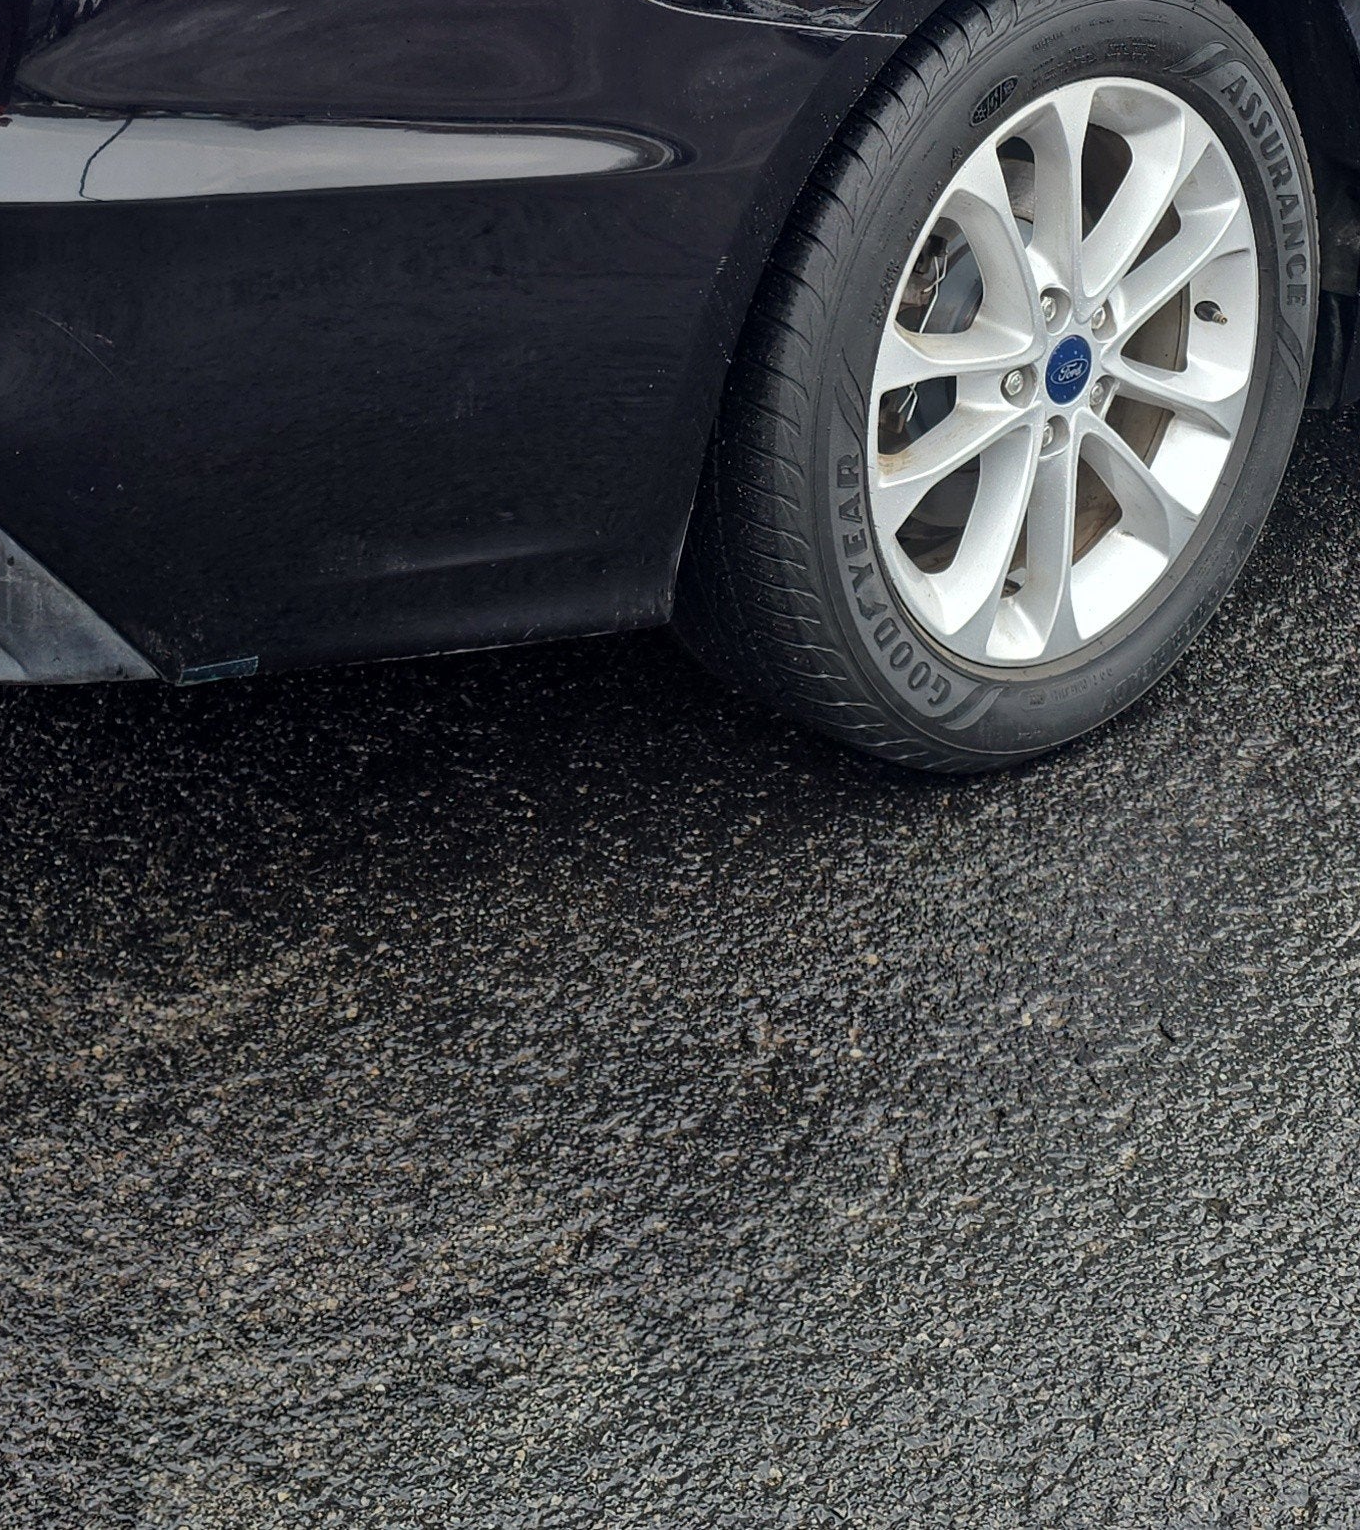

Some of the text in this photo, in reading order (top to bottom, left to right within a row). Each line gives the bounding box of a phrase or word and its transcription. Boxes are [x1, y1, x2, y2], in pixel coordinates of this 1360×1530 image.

[1220, 74, 1308, 306] ASSURANCE
[1058, 362, 1083, 381] Ford
[836, 453, 952, 707] GOODYEAR
